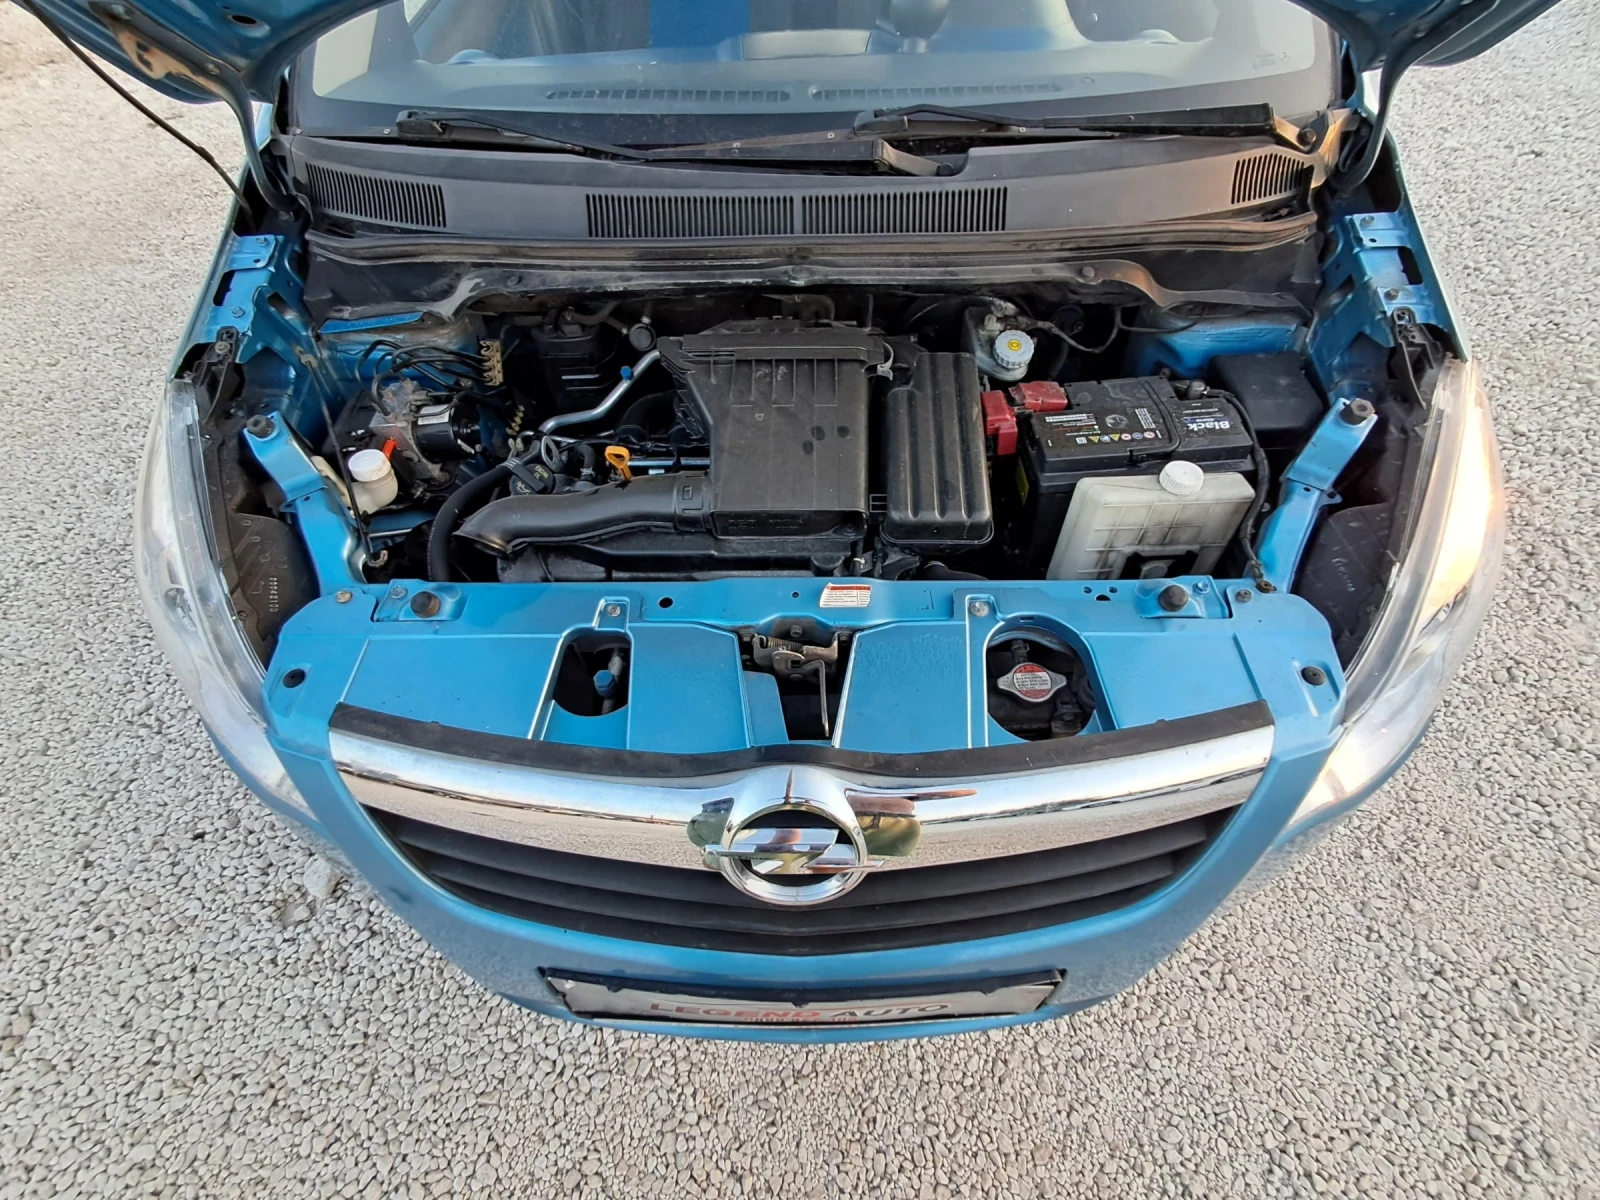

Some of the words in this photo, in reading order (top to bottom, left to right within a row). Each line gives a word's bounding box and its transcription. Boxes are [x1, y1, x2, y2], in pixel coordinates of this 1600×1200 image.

[1188, 421, 1230, 431] Black
[650, 1003, 820, 1018] LEGEND
[829, 1004, 949, 1018] AUTO
